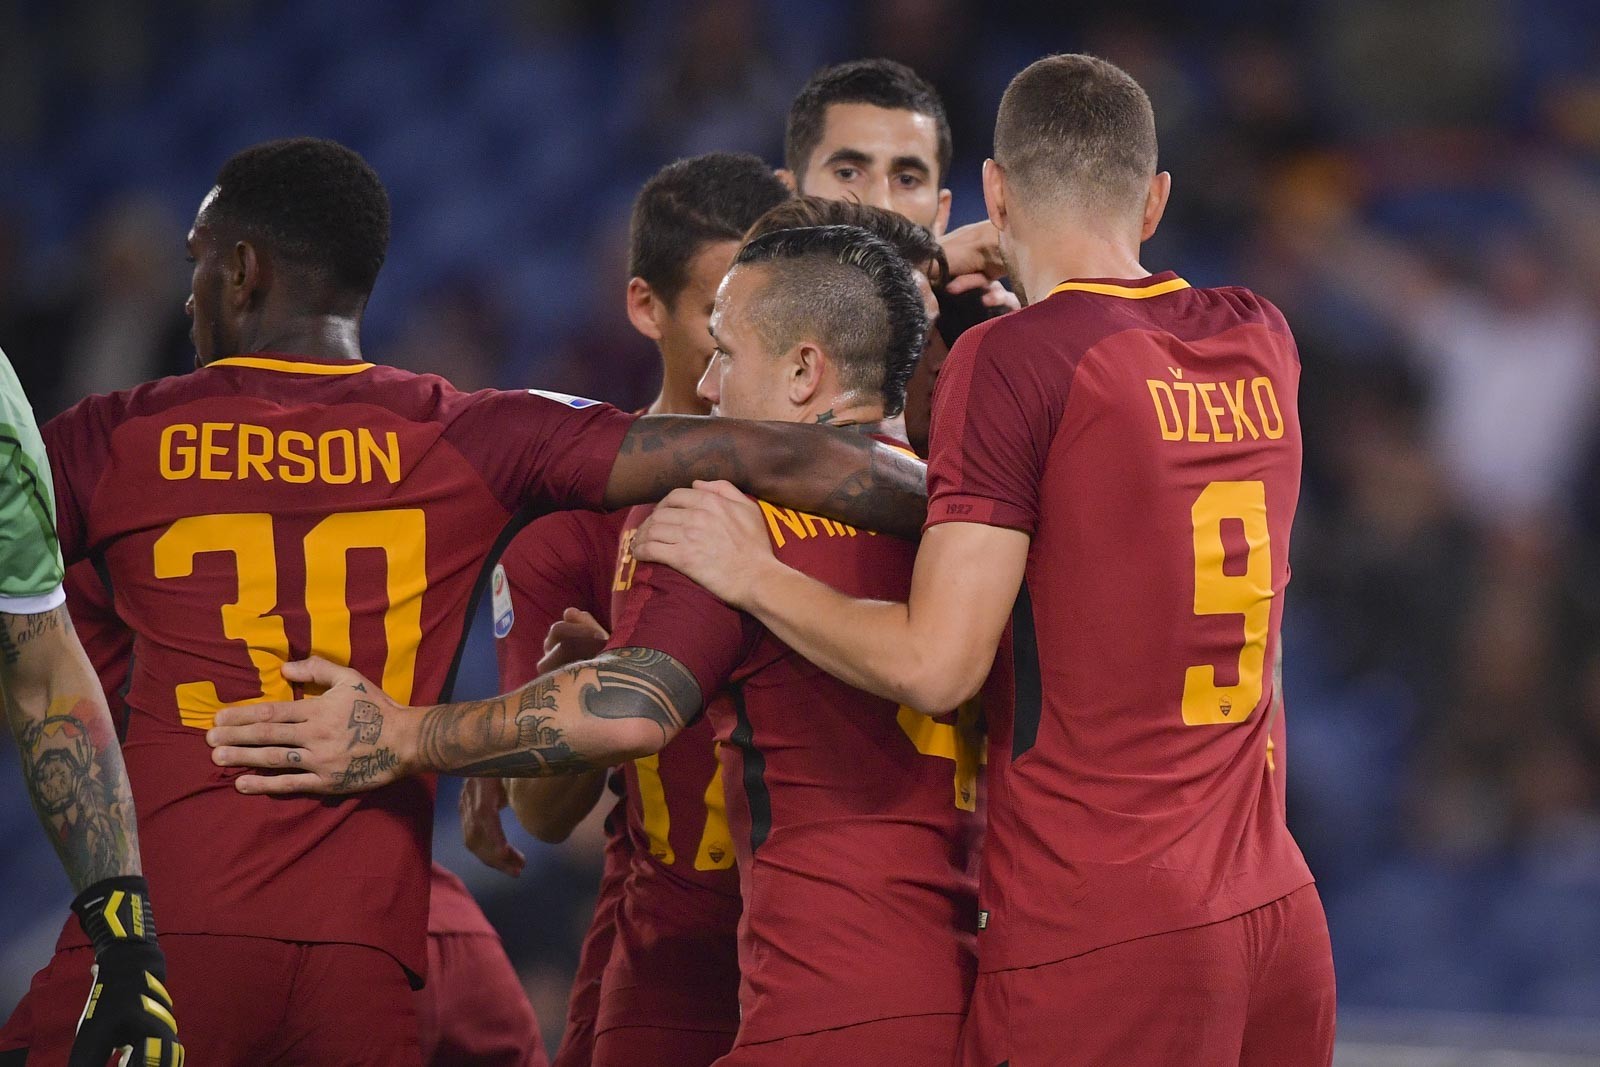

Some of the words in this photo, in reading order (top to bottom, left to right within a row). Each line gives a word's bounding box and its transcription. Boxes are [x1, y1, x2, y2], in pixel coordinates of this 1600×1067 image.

[1146, 367, 1285, 443] DŽEKO
[159, 422, 401, 485] GERSON
[946, 503, 974, 515] 1927
[153, 508, 428, 732] 30
[1181, 480, 1275, 726] 9
